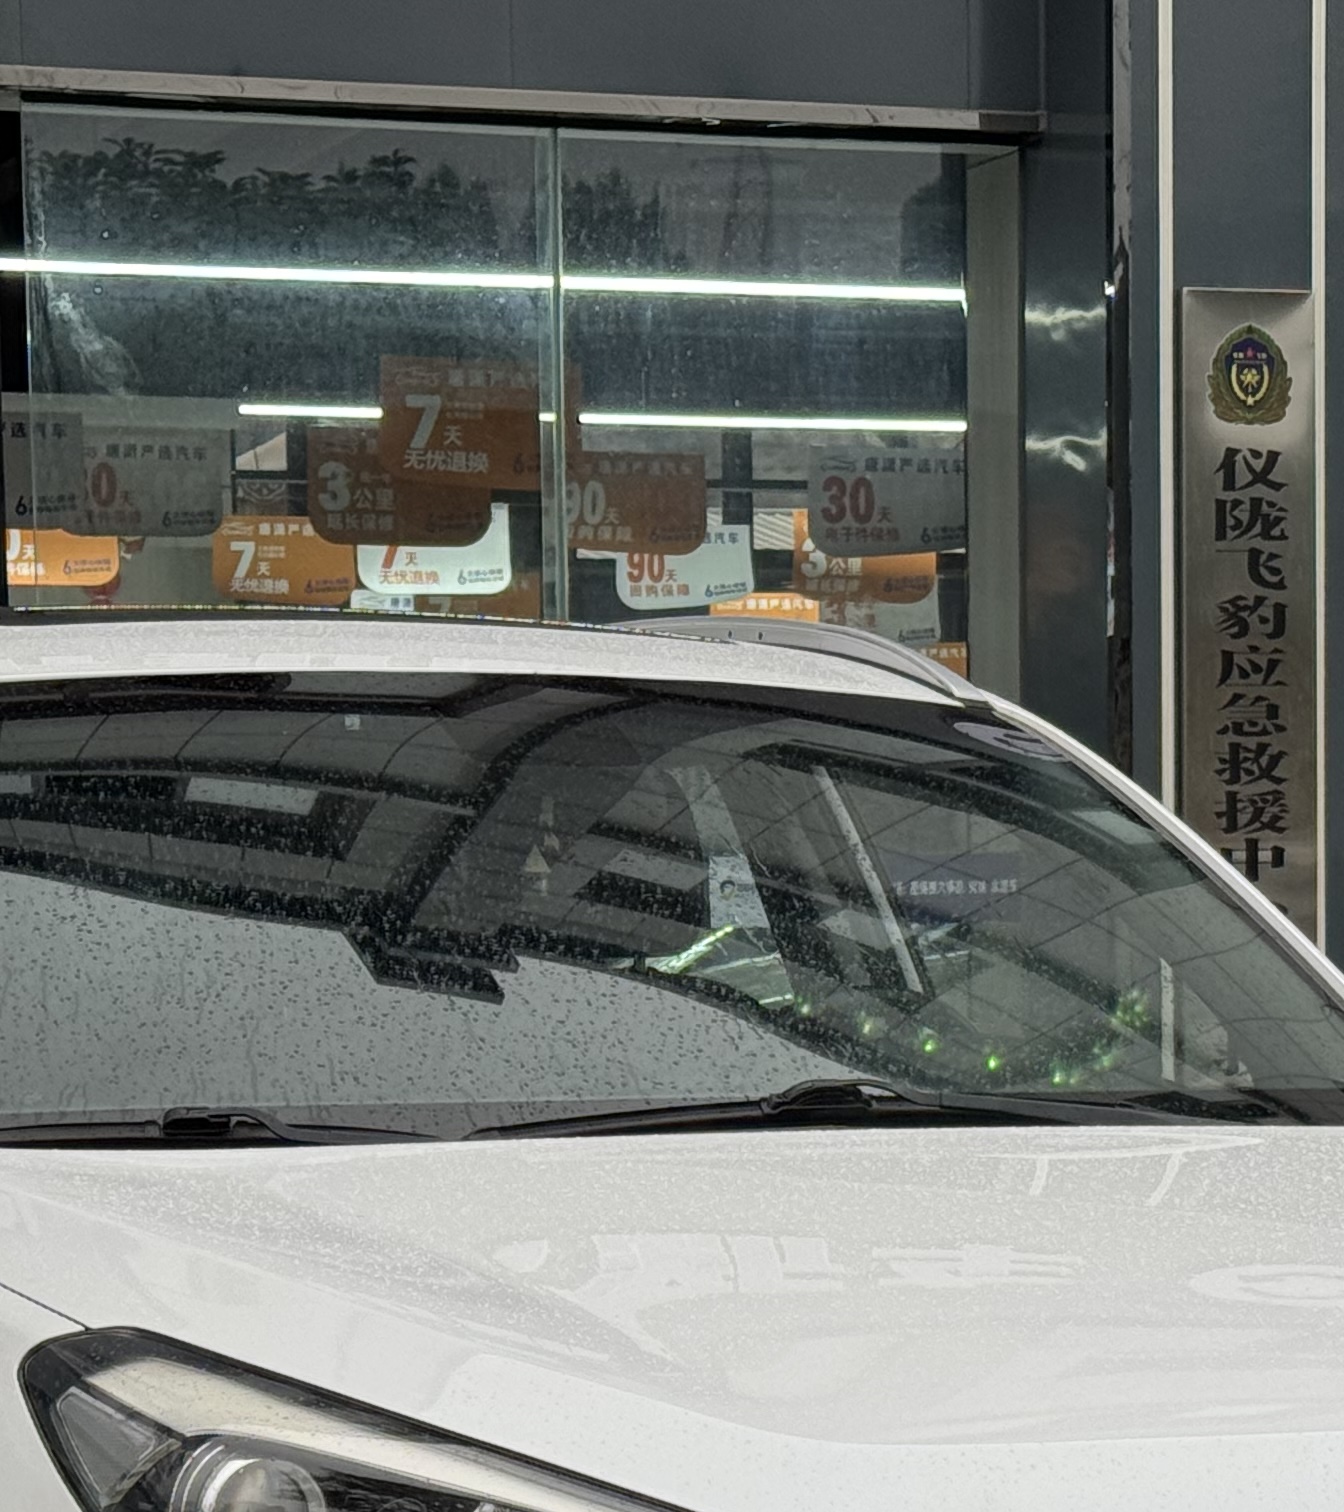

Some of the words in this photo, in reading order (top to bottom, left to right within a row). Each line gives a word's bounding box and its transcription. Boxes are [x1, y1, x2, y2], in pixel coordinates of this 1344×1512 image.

[405, 394, 441, 448] 7
[444, 427, 462, 446] 天
[404, 451, 489, 473] 无忧退换
[318, 461, 351, 511] 3
[353, 489, 395, 510] 公里
[821, 476, 893, 524] 30天
[230, 541, 255, 580] 7
[257, 561, 270, 576] 天
[379, 571, 440, 586] 无忧退换
[229, 578, 289, 595] 无忧退换
[1213, 446, 1290, 920] 仪陇飞豹应急救援中
